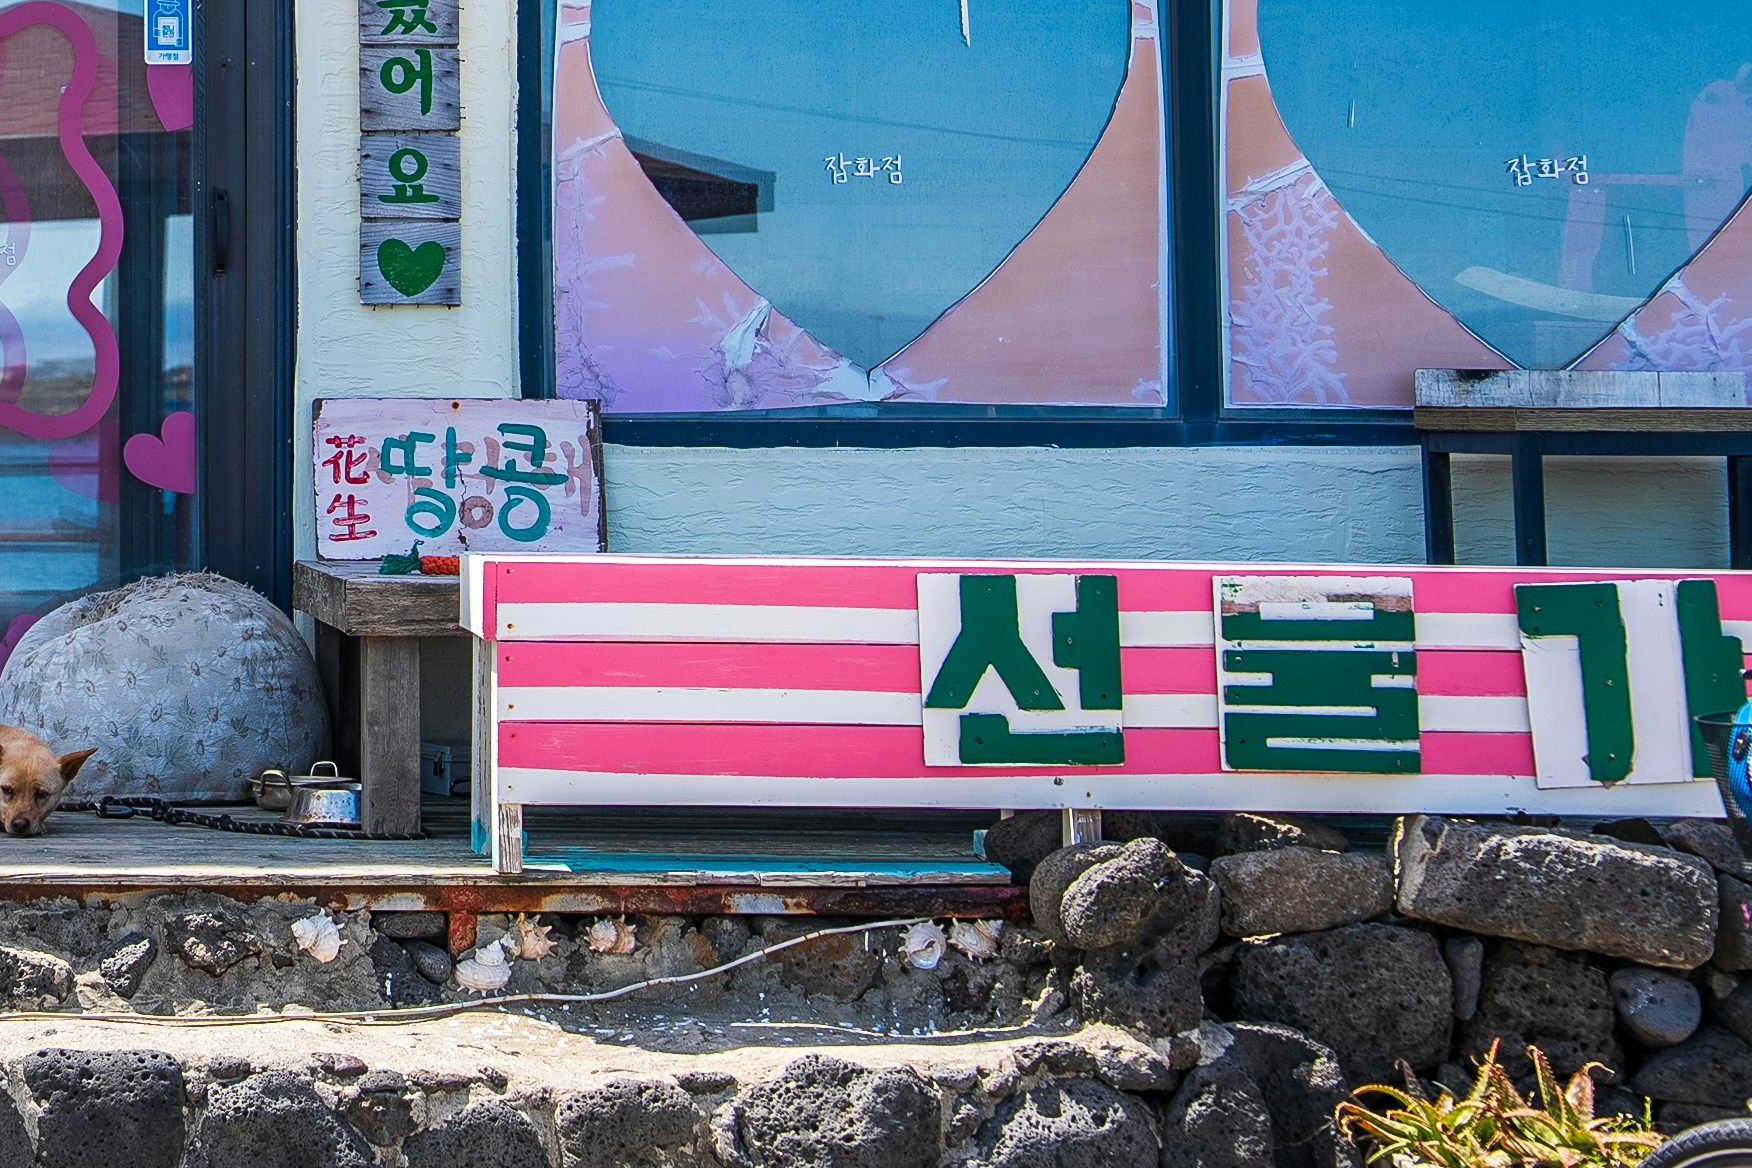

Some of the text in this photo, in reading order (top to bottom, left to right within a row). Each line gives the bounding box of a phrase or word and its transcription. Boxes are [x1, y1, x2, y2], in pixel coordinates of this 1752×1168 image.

[823, 152, 903, 184] 잡화점
[1507, 154, 1589, 187] 잡화점
[322, 434, 378, 542] 花生
[380, 422, 569, 542] 땅콩
